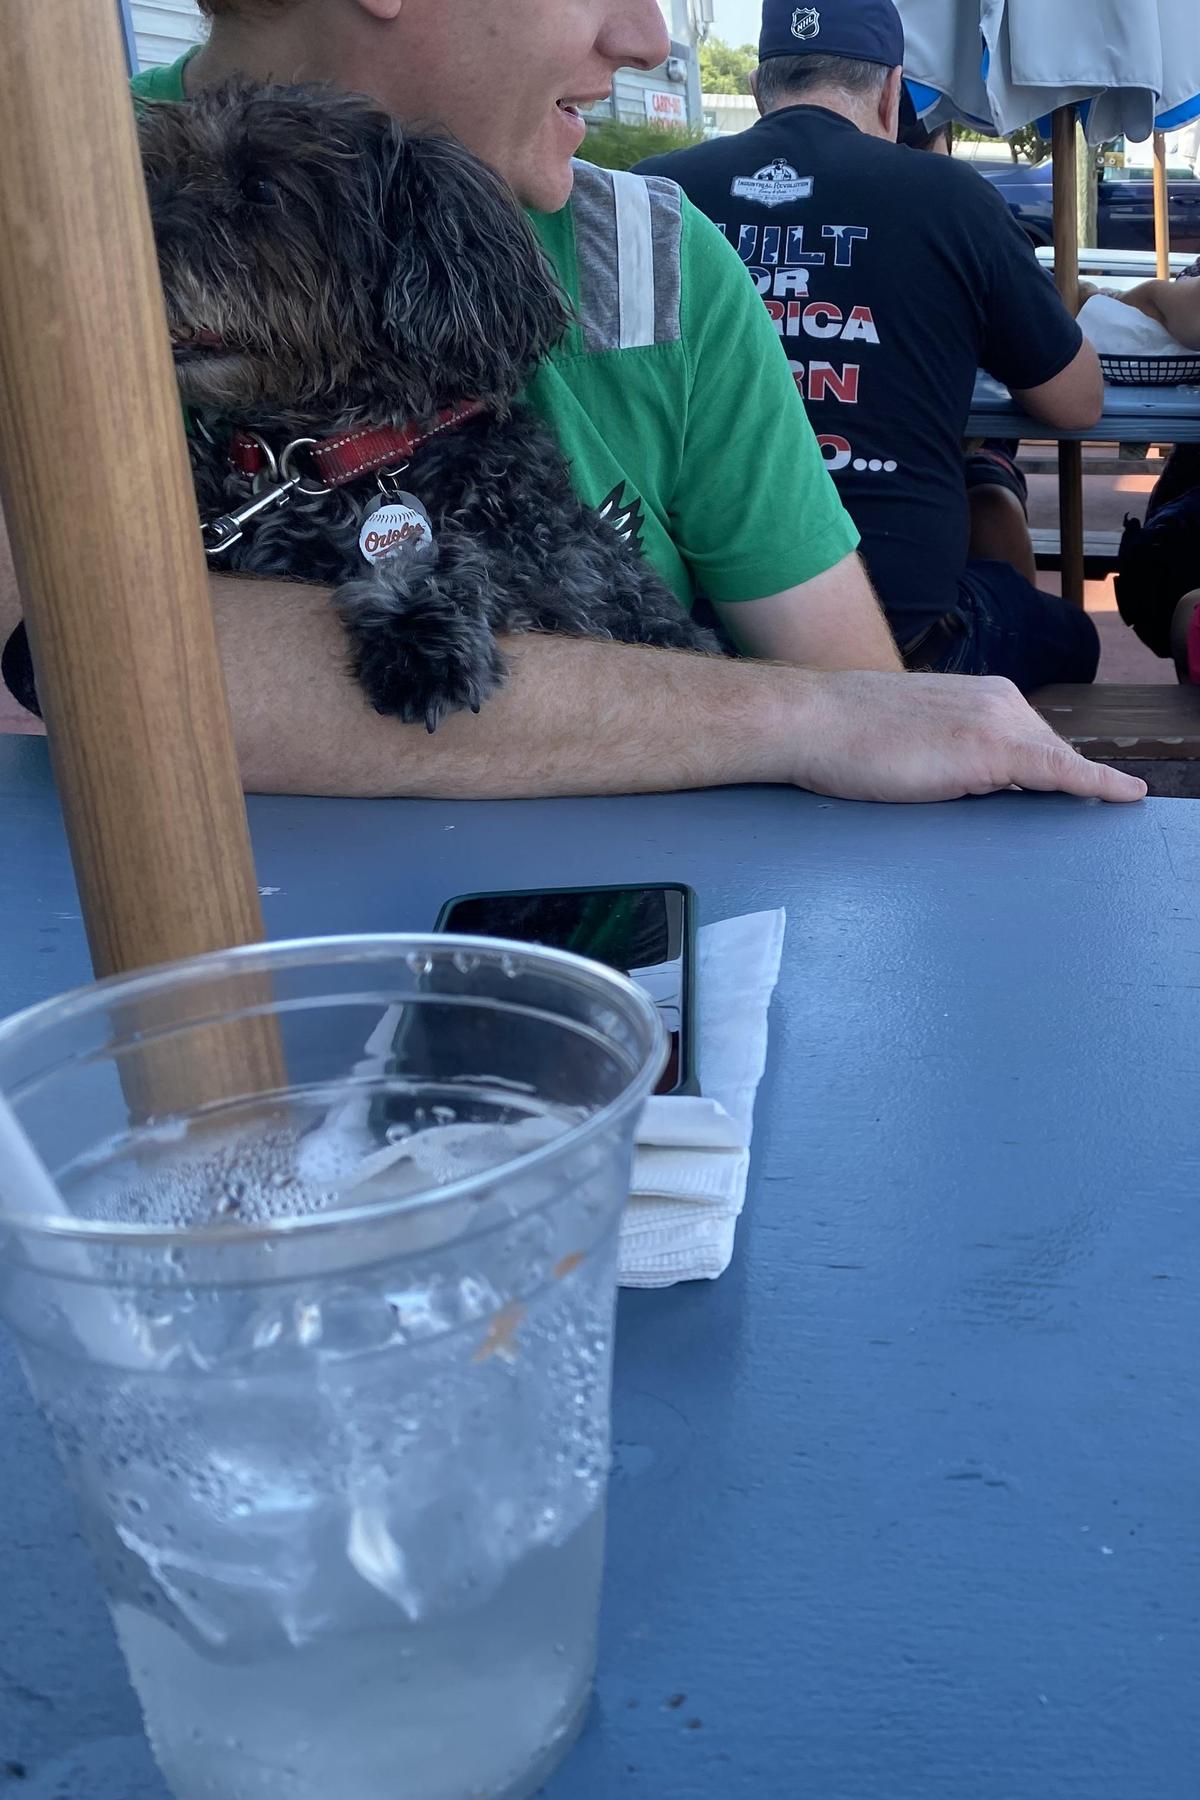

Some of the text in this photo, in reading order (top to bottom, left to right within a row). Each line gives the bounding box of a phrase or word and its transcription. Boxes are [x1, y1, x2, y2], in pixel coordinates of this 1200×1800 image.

[796, 16, 815, 32] NHL
[715, 223, 869, 267] UILT
[747, 266, 810, 297] OR
[763, 301, 880, 344] RICA
